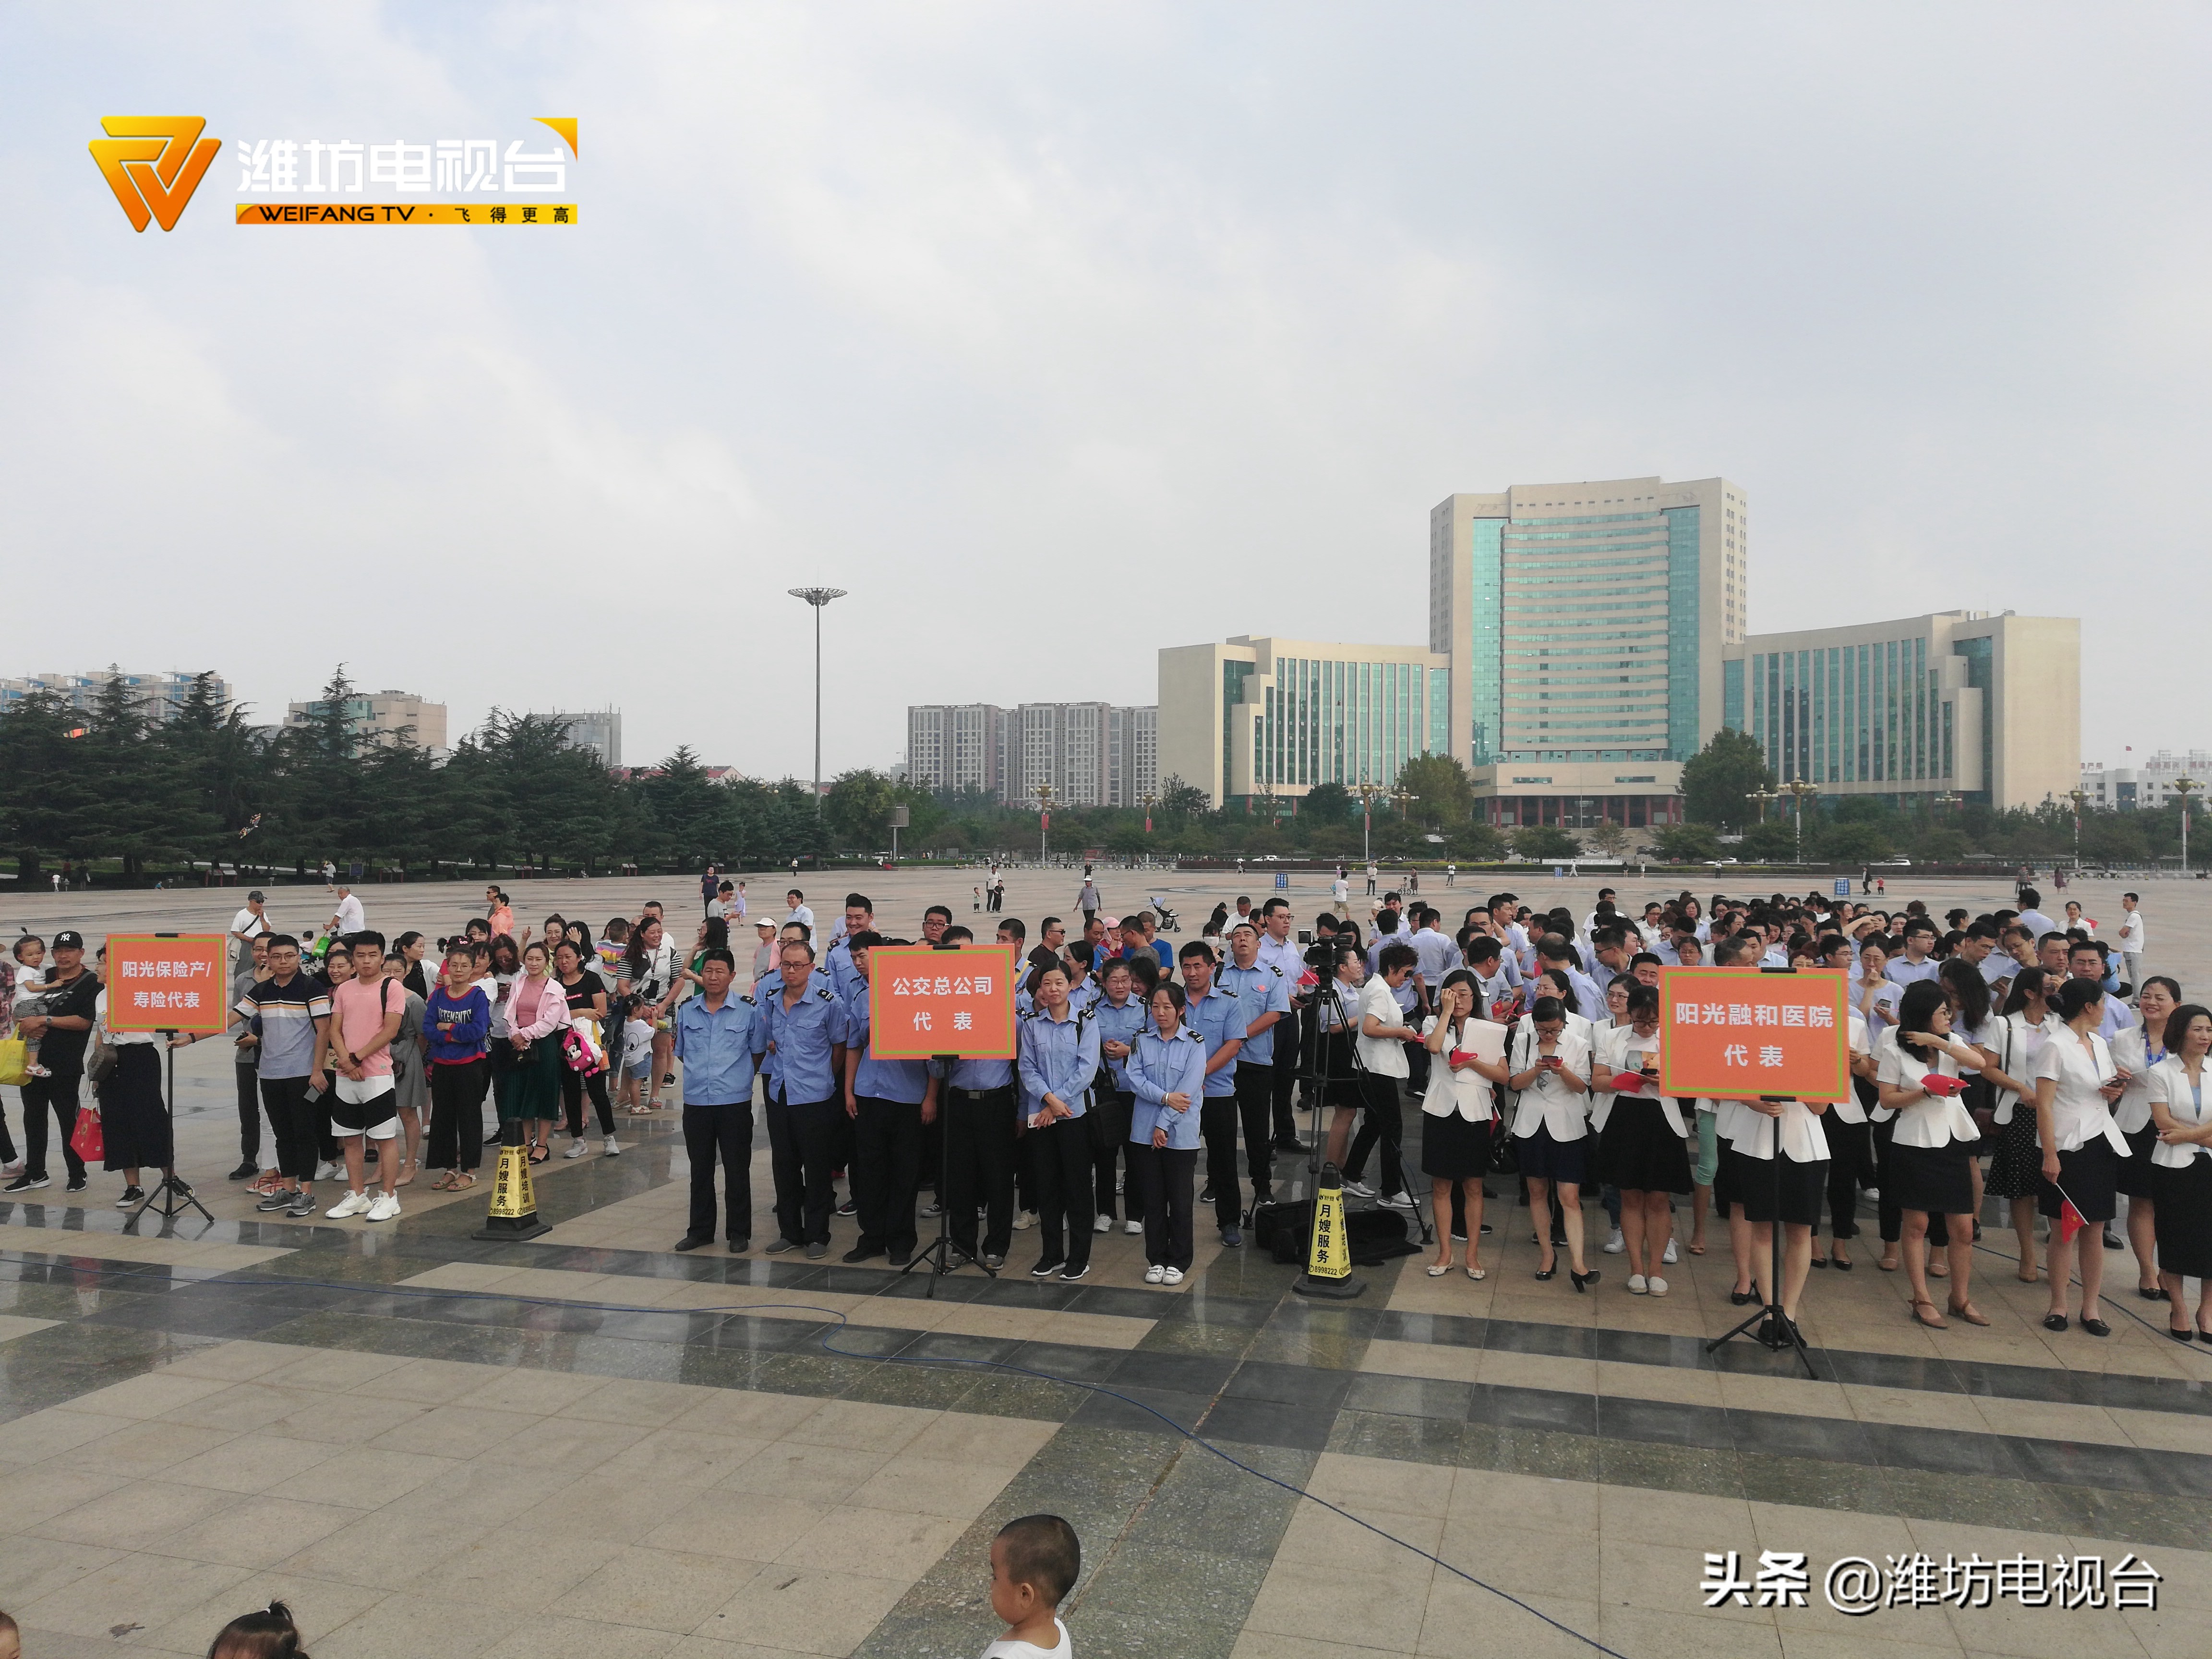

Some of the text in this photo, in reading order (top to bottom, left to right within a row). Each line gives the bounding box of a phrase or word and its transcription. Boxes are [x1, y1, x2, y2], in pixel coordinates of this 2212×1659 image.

[122, 960, 211, 978] 阳光保险产/
[892, 976, 992, 996] 公交总公司
[133, 990, 200, 1009] 寿险代表
[913, 1010, 973, 1032] 代表
[1675, 1002, 1834, 1028] 阳光融和医院
[1724, 1044, 1784, 1068] 代表
[496, 1158, 509, 1206] 月嫂服务
[1317, 1204, 1331, 1263] 月嫂服务
[1314, 1265, 1337, 1275] 8998222
